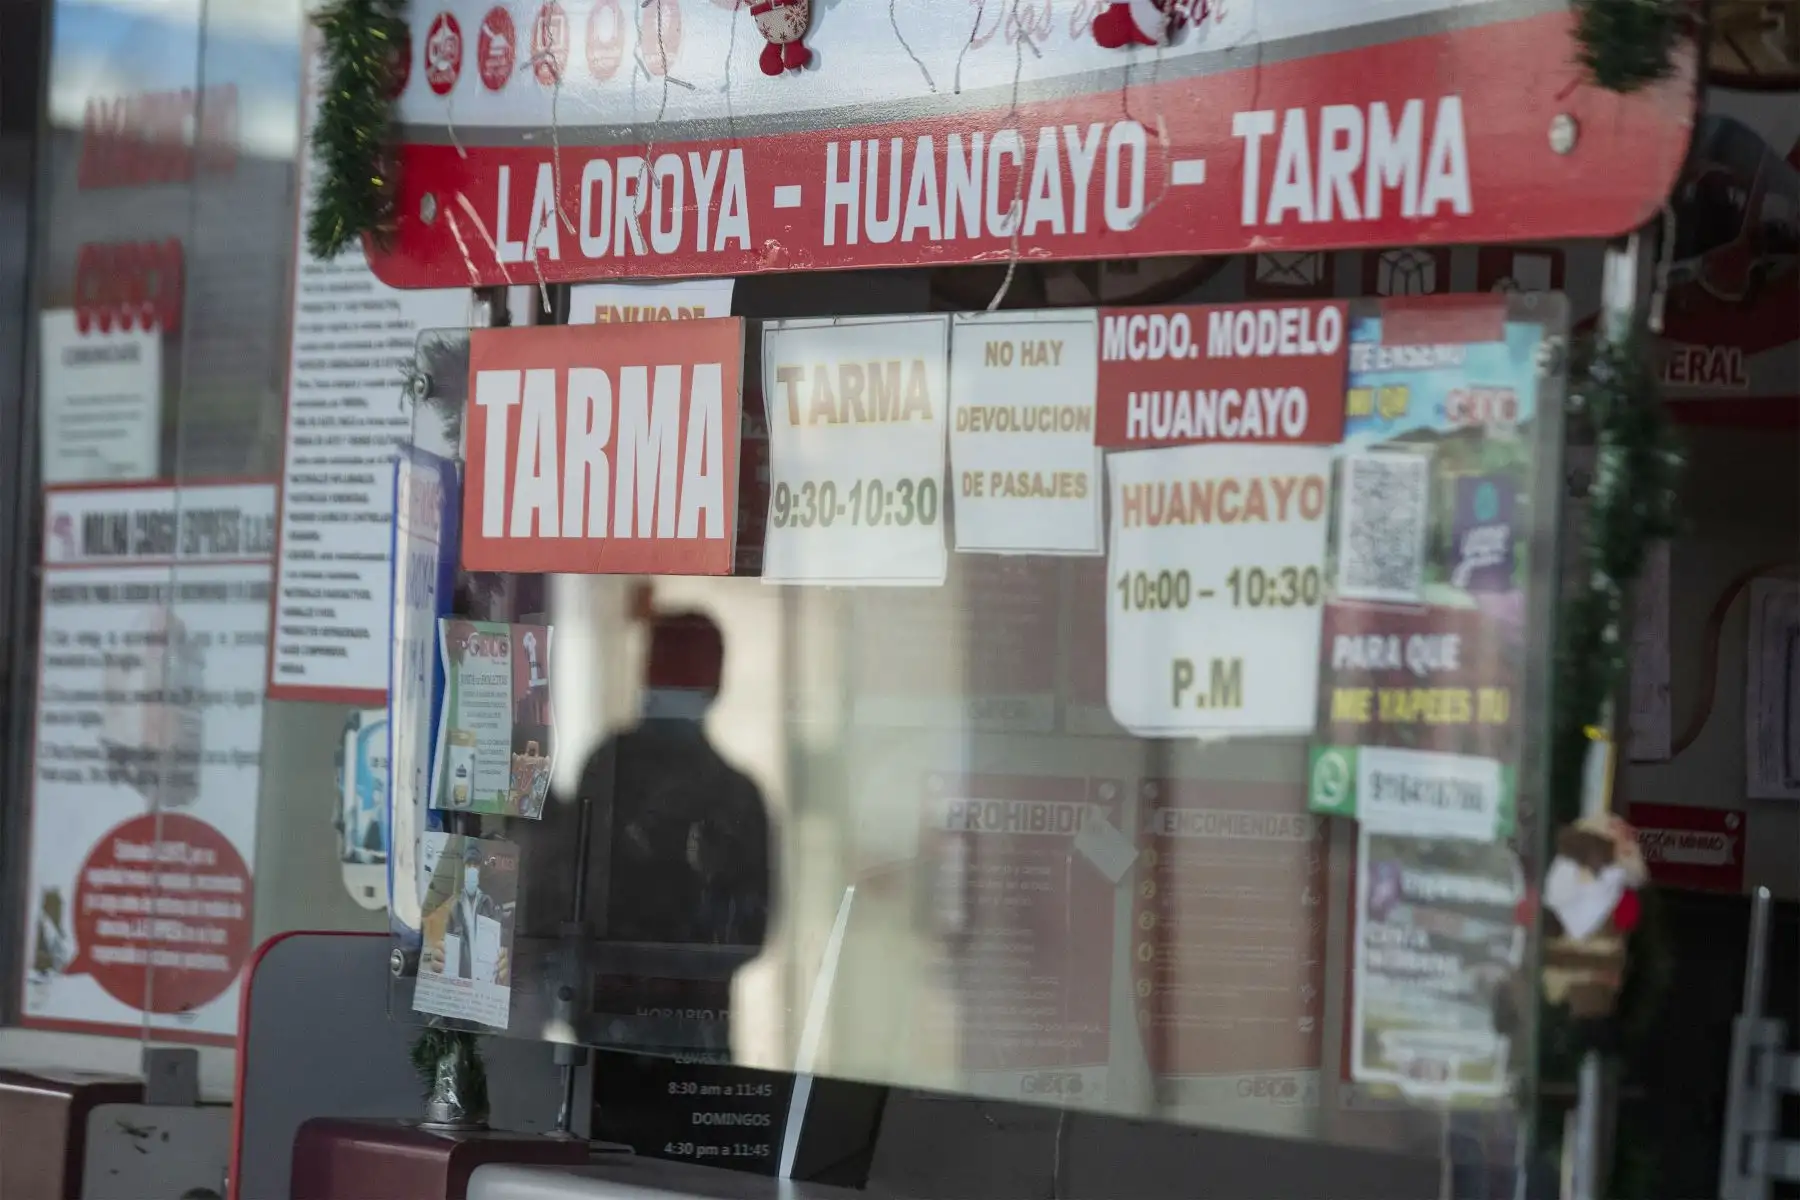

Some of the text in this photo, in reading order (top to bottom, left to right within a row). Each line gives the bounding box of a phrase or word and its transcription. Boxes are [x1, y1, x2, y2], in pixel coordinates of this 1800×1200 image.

[496, 162, 560, 263] LA
[580, 148, 751, 259] OROYA
[823, 120, 1148, 246] HUANCAYO
[1232, 96, 1473, 227] TARMA
[984, 340, 1064, 367] NO HAY
[1102, 306, 1342, 361] MCDO. MODELO
[777, 360, 933, 427] TARMA
[1126, 387, 1308, 439] HUANCAYO
[956, 406, 1092, 432] DEVOLUCION
[476, 363, 725, 539] TARMA
[774, 478, 938, 528] 9:30-10:30
[962, 472, 1089, 499] DE PASAJES
[1122, 474, 1326, 528] HUANCAYO
[1117, 569, 1191, 611] 10:00
[1226, 565, 1320, 608] 10:30
[1172, 657, 1243, 708] P.M
[1163, 810, 1305, 839] ENCOMIENDAS
[668, 1082, 773, 1097] 8:30 am a 11:45
[692, 1112, 771, 1127] DOMINGOS
[664, 1142, 770, 1159] 4:30 pm a 11:45
